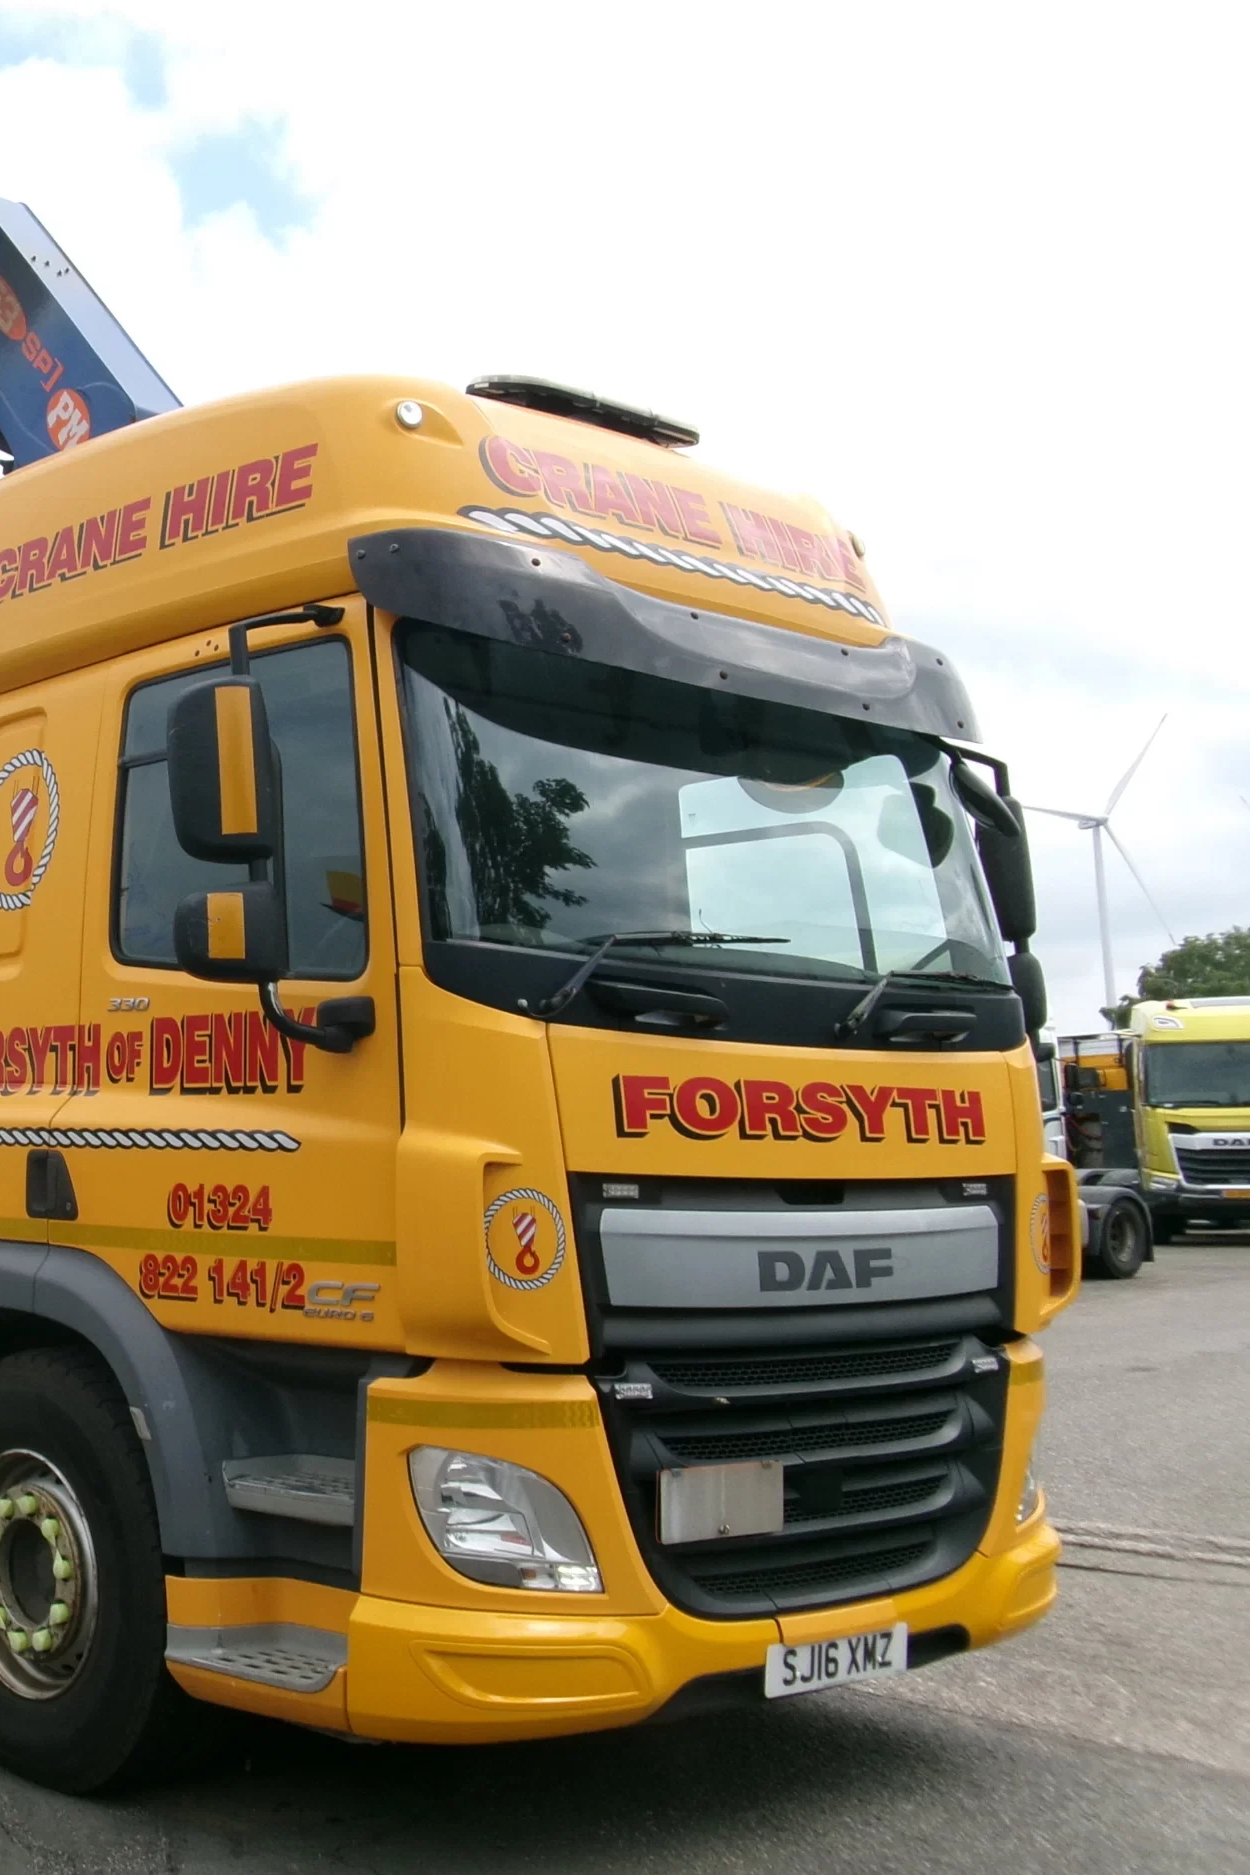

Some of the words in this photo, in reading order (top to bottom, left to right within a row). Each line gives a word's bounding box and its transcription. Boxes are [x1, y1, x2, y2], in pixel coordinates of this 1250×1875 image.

[159, 443, 318, 550] HIRE
[478, 435, 722, 550] CRANE
[718, 501, 867, 592] HIRE
[107, 997, 150, 1013] 330
[105, 1031, 144, 1085] OF
[149, 1006, 317, 1097] DENNY
[612, 1073, 987, 1145] FORSYTH
[167, 1183, 273, 1231] 01324
[139, 1253, 198, 1302] 822
[207, 1258, 306, 1312] 141/2
[306, 1280, 381, 1307] CF
[757, 1247, 895, 1293] DAF
[782, 1641, 840, 1687] SJ16
[847, 1632, 893, 1675] XMZ
